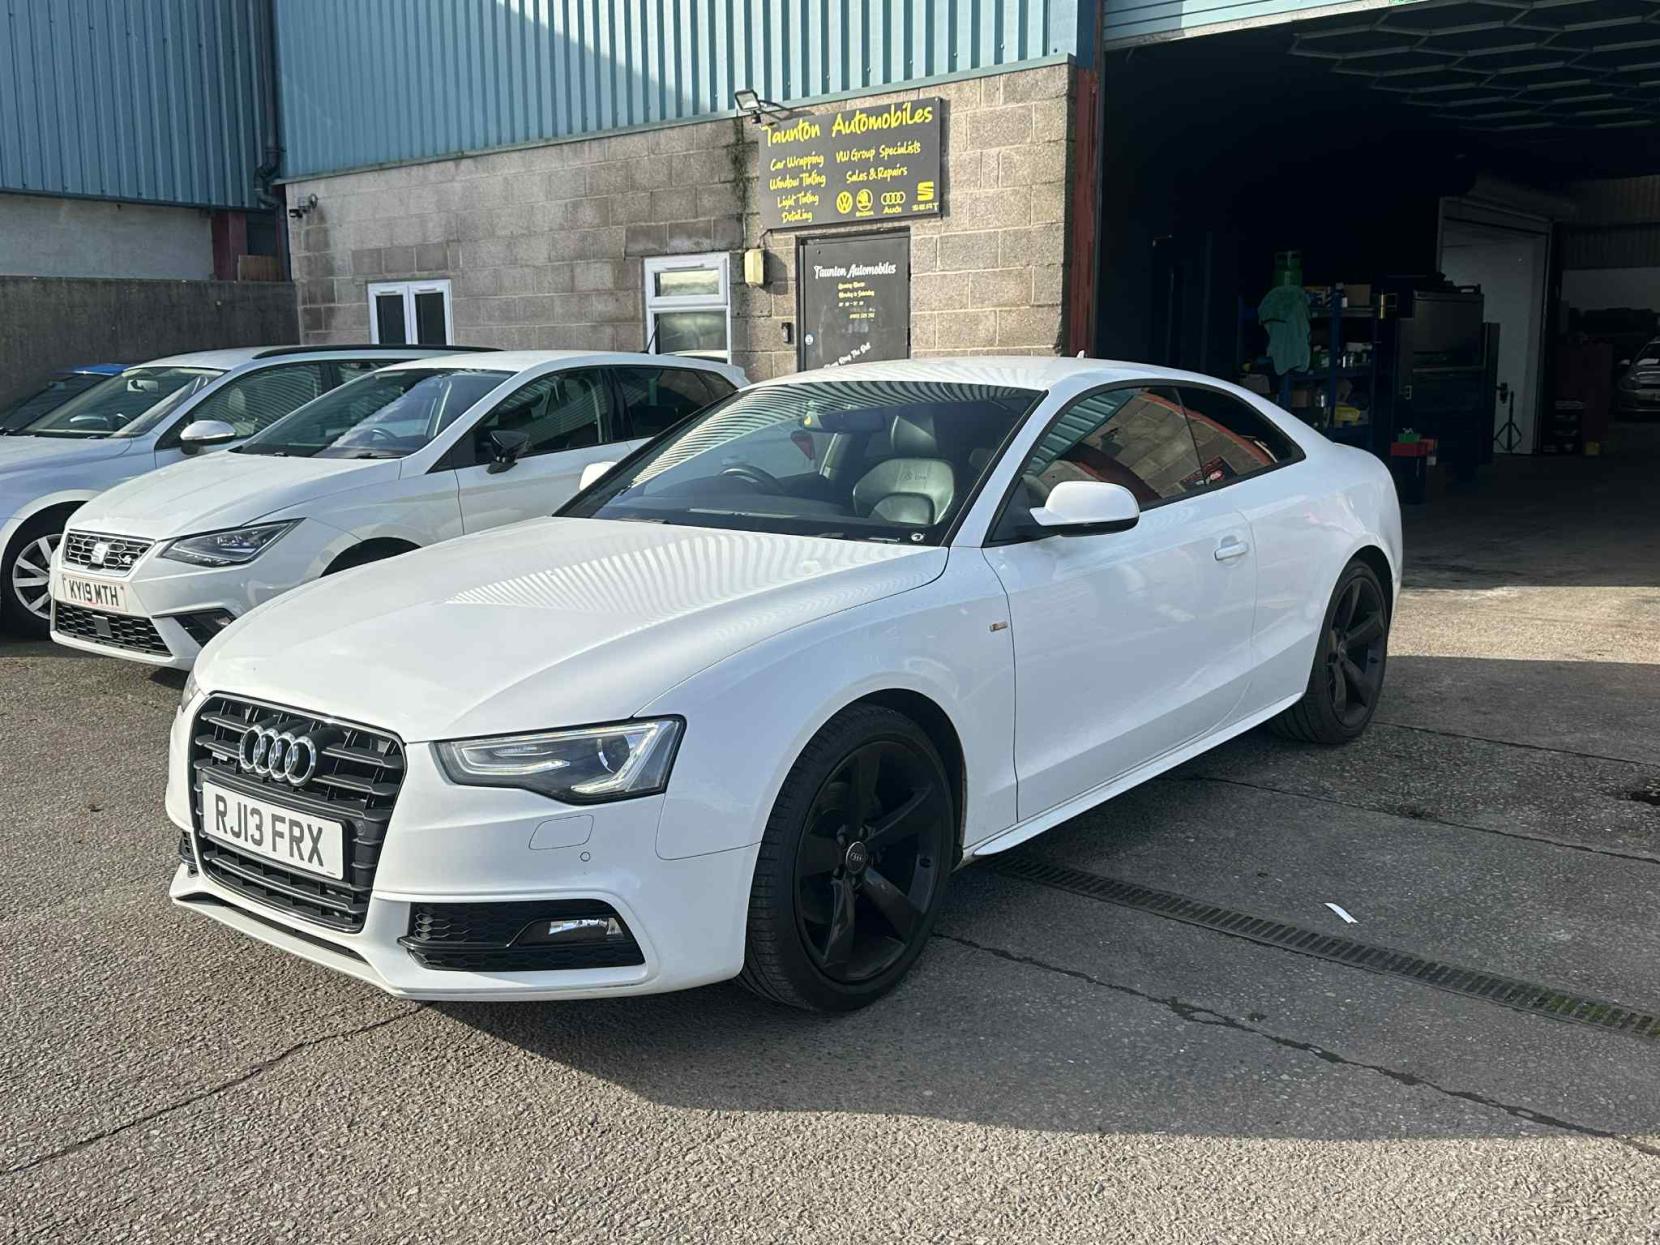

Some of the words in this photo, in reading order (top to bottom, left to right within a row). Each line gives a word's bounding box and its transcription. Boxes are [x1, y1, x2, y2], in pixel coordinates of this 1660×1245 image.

[760, 119, 821, 147] Taunton
[832, 102, 933, 138] Automobiles
[770, 158, 786, 171] Car
[787, 151, 824, 170] Wrapping
[835, 150, 850, 163] VW
[851, 147, 876, 162] Group
[879, 140, 921, 160] Specialists
[769, 174, 800, 191] Window
[846, 169, 868, 184] Sales
[868, 168, 878, 181] &
[878, 163, 908, 182] Repairs
[777, 194, 796, 210] Light
[883, 206, 902, 215] Audi
[814, 265, 847, 280] Taunton
[847, 261, 896, 279] Automobiles
[68, 579, 93, 602] KY19
[93, 583, 120, 607] MTH
[215, 793, 264, 847] RJ13
[271, 813, 324, 867] FRX
